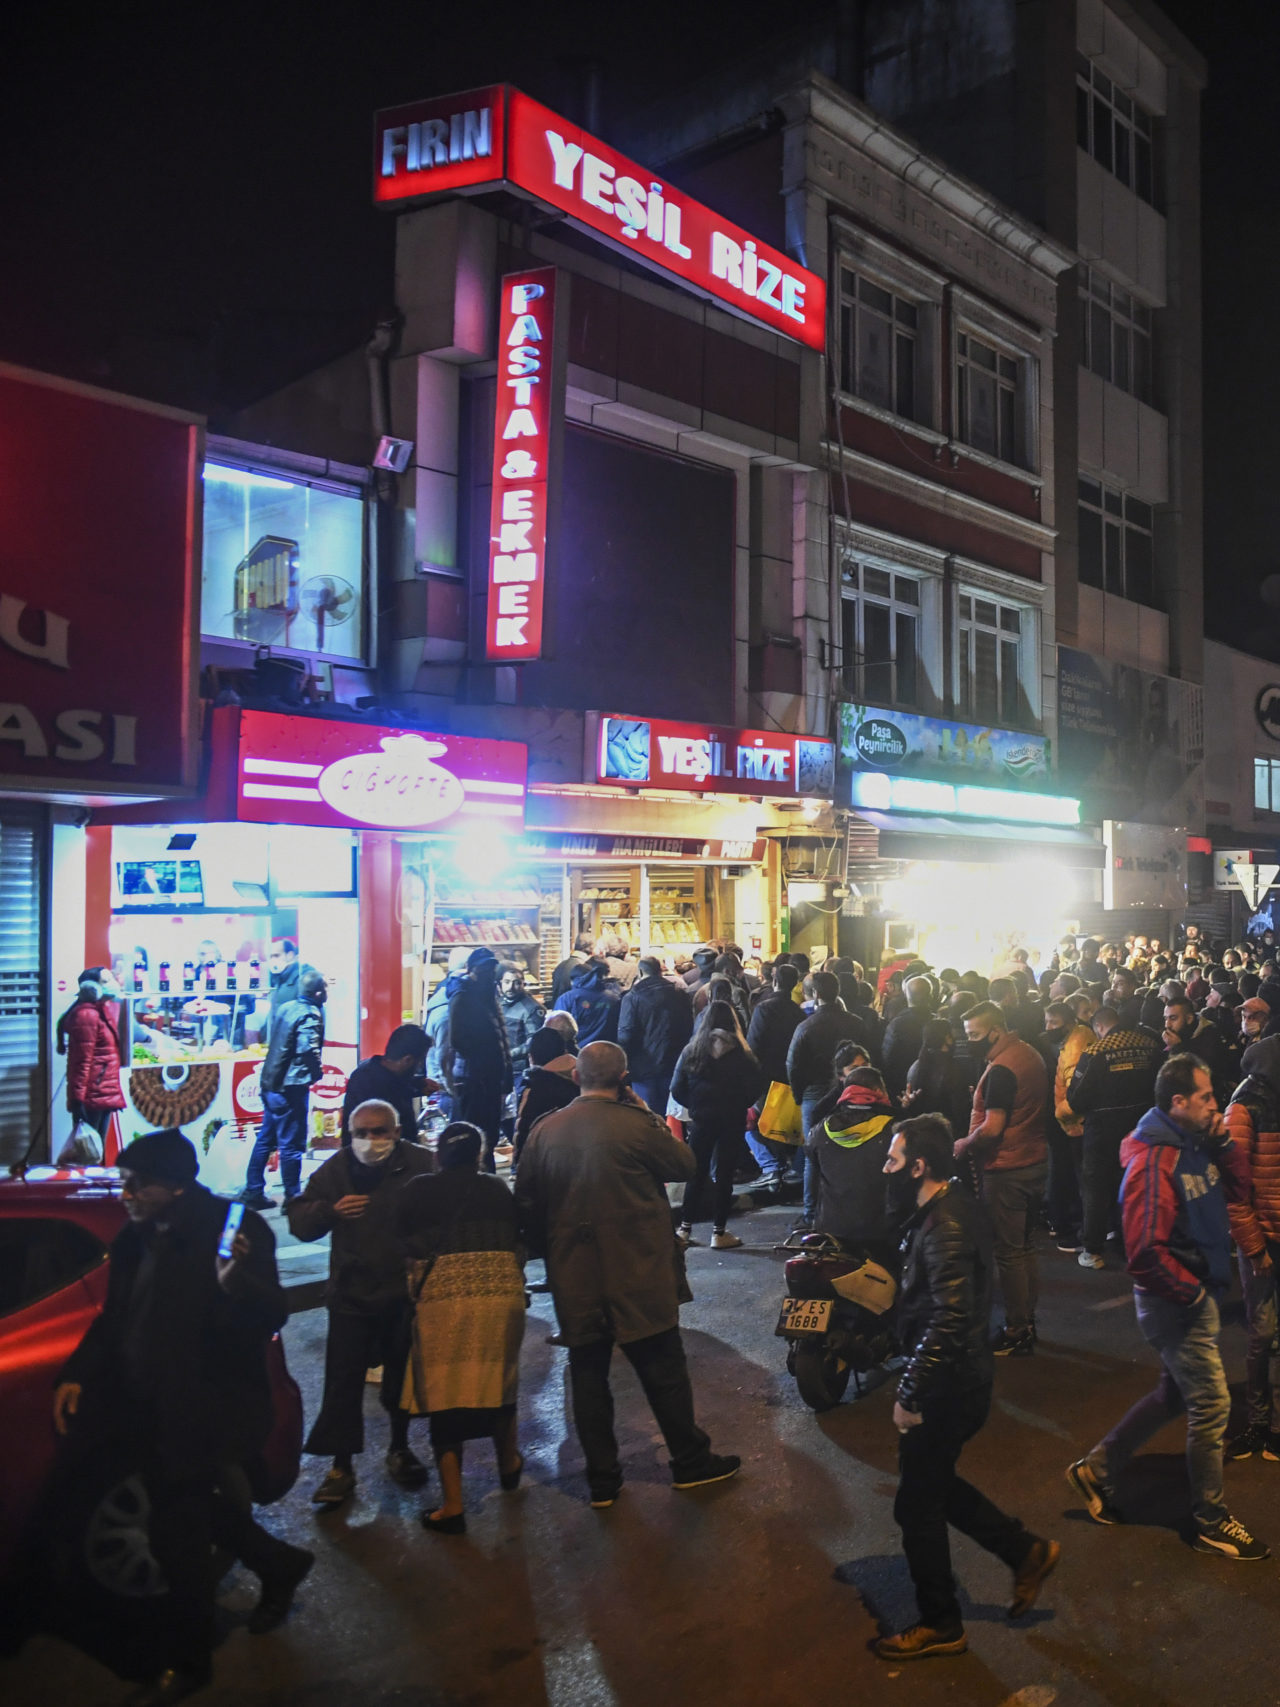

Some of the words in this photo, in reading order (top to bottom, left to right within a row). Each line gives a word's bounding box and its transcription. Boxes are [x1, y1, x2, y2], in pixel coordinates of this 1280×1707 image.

[382, 107, 492, 177] FIRIN
[546, 129, 691, 259] YEŞİL
[712, 231, 806, 323] RİZE
[501, 283, 545, 439] PASTA
[501, 450, 537, 478] &
[493, 489, 537, 646] EKMEK
[858, 735, 904, 755] Peynircilik
[871, 722, 892, 742] Paşa
[657, 733, 733, 782] YEŞİL
[736, 738, 791, 782] RİZE
[790, 1315, 818, 1328] 1688
[809, 1301, 826, 1314] ES
